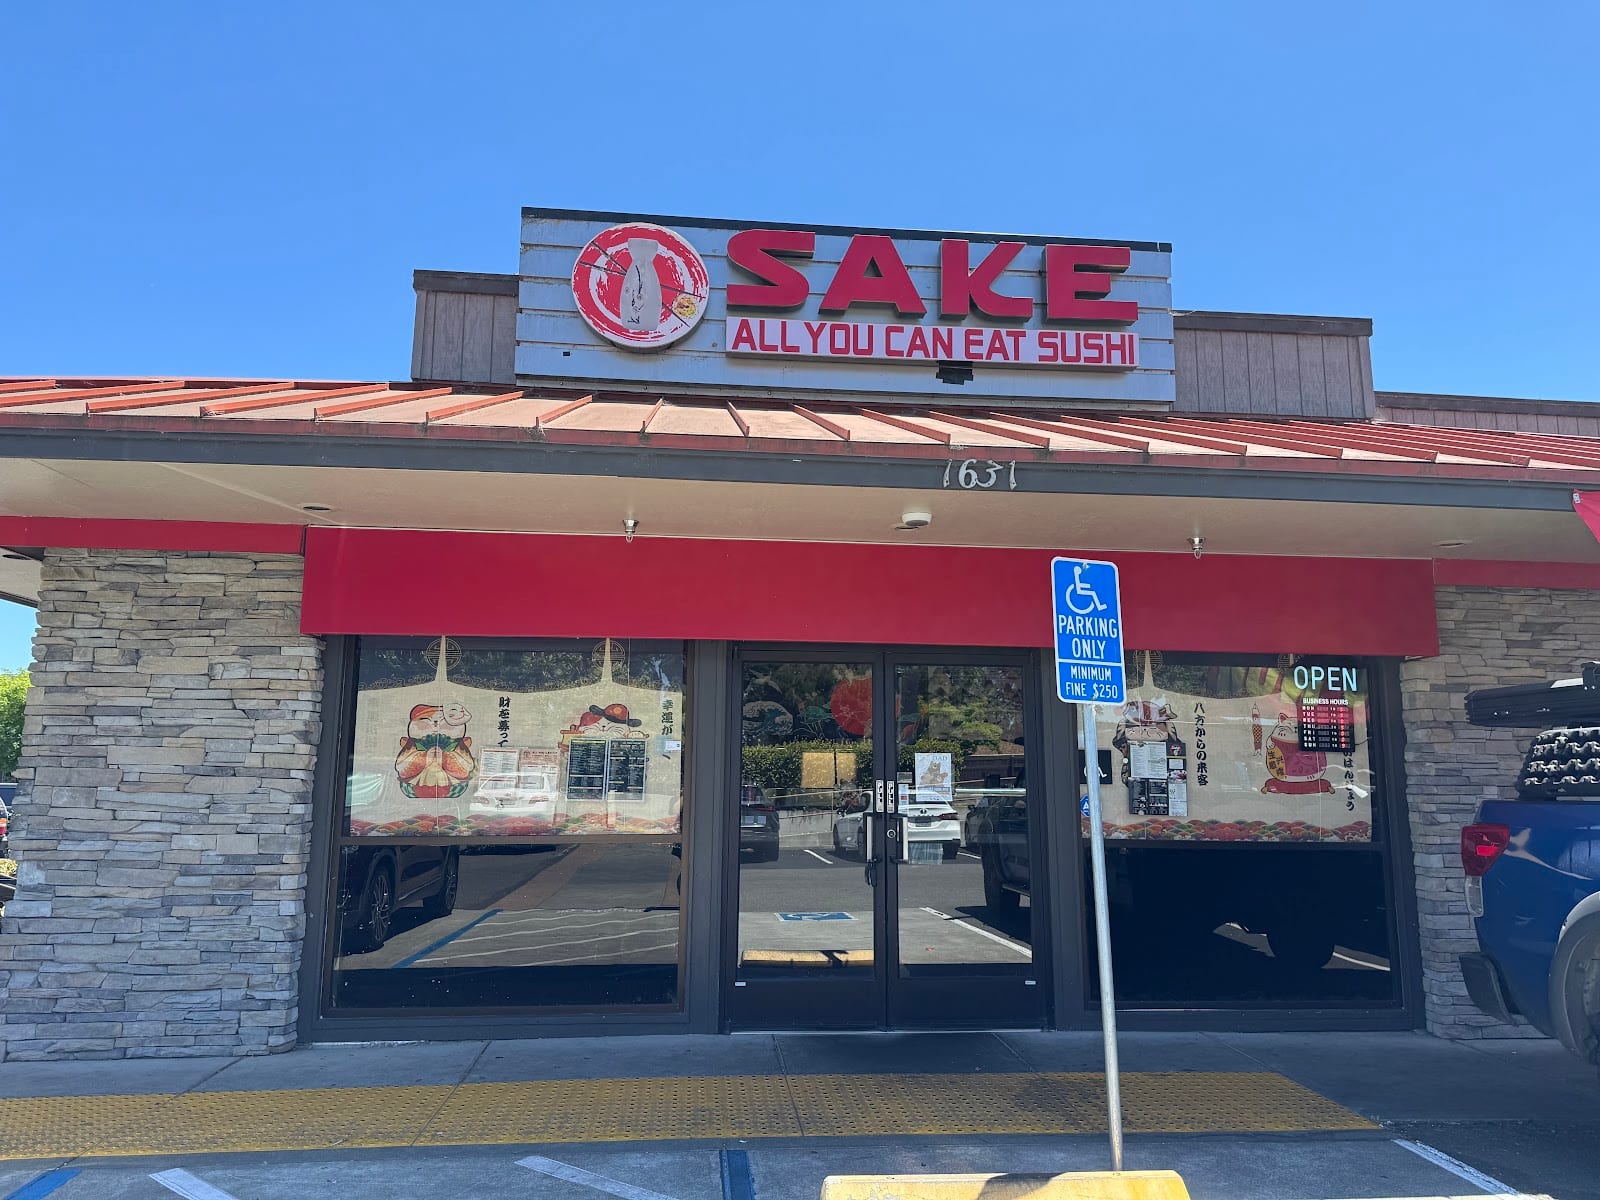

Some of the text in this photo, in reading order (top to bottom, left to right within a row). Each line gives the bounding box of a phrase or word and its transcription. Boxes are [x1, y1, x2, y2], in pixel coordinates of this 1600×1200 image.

[727, 228, 1139, 324] SAKE
[731, 318, 1135, 365] ALL YOU CAN EAT SUSHI
[943, 458, 1017, 490] 1631
[1058, 614, 1118, 638] PARKING
[1071, 637, 1107, 660] ONLY
[1070, 665, 1112, 682] MINIMUM
[1293, 665, 1358, 692] OPEN
[1065, 681, 1119, 699] FINE $250
[1302, 697, 1329, 705] BUSINESS
